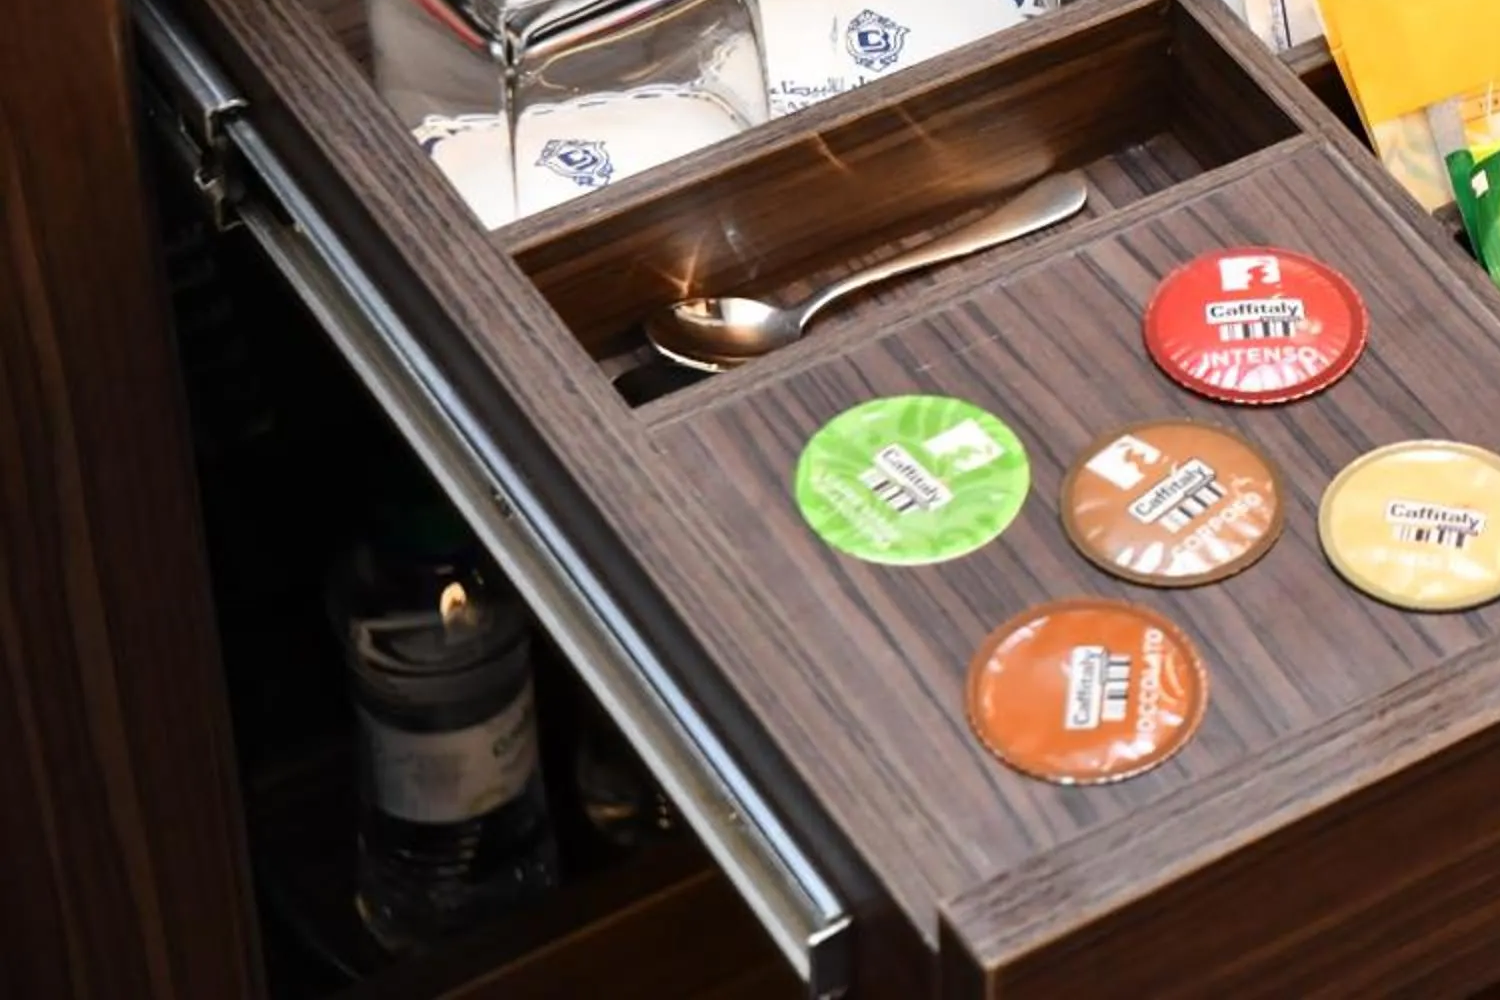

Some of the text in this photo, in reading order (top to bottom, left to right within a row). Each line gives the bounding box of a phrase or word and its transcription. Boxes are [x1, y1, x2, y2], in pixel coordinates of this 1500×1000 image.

[1210, 302, 1299, 318] Caffitaly
[1202, 346, 1318, 370] INTENSO
[883, 448, 941, 504] Caffitaly
[1135, 465, 1205, 516] Caffitaly
[1390, 503, 1479, 530] Caffitaly
[1073, 650, 1101, 725] Caffitaly
